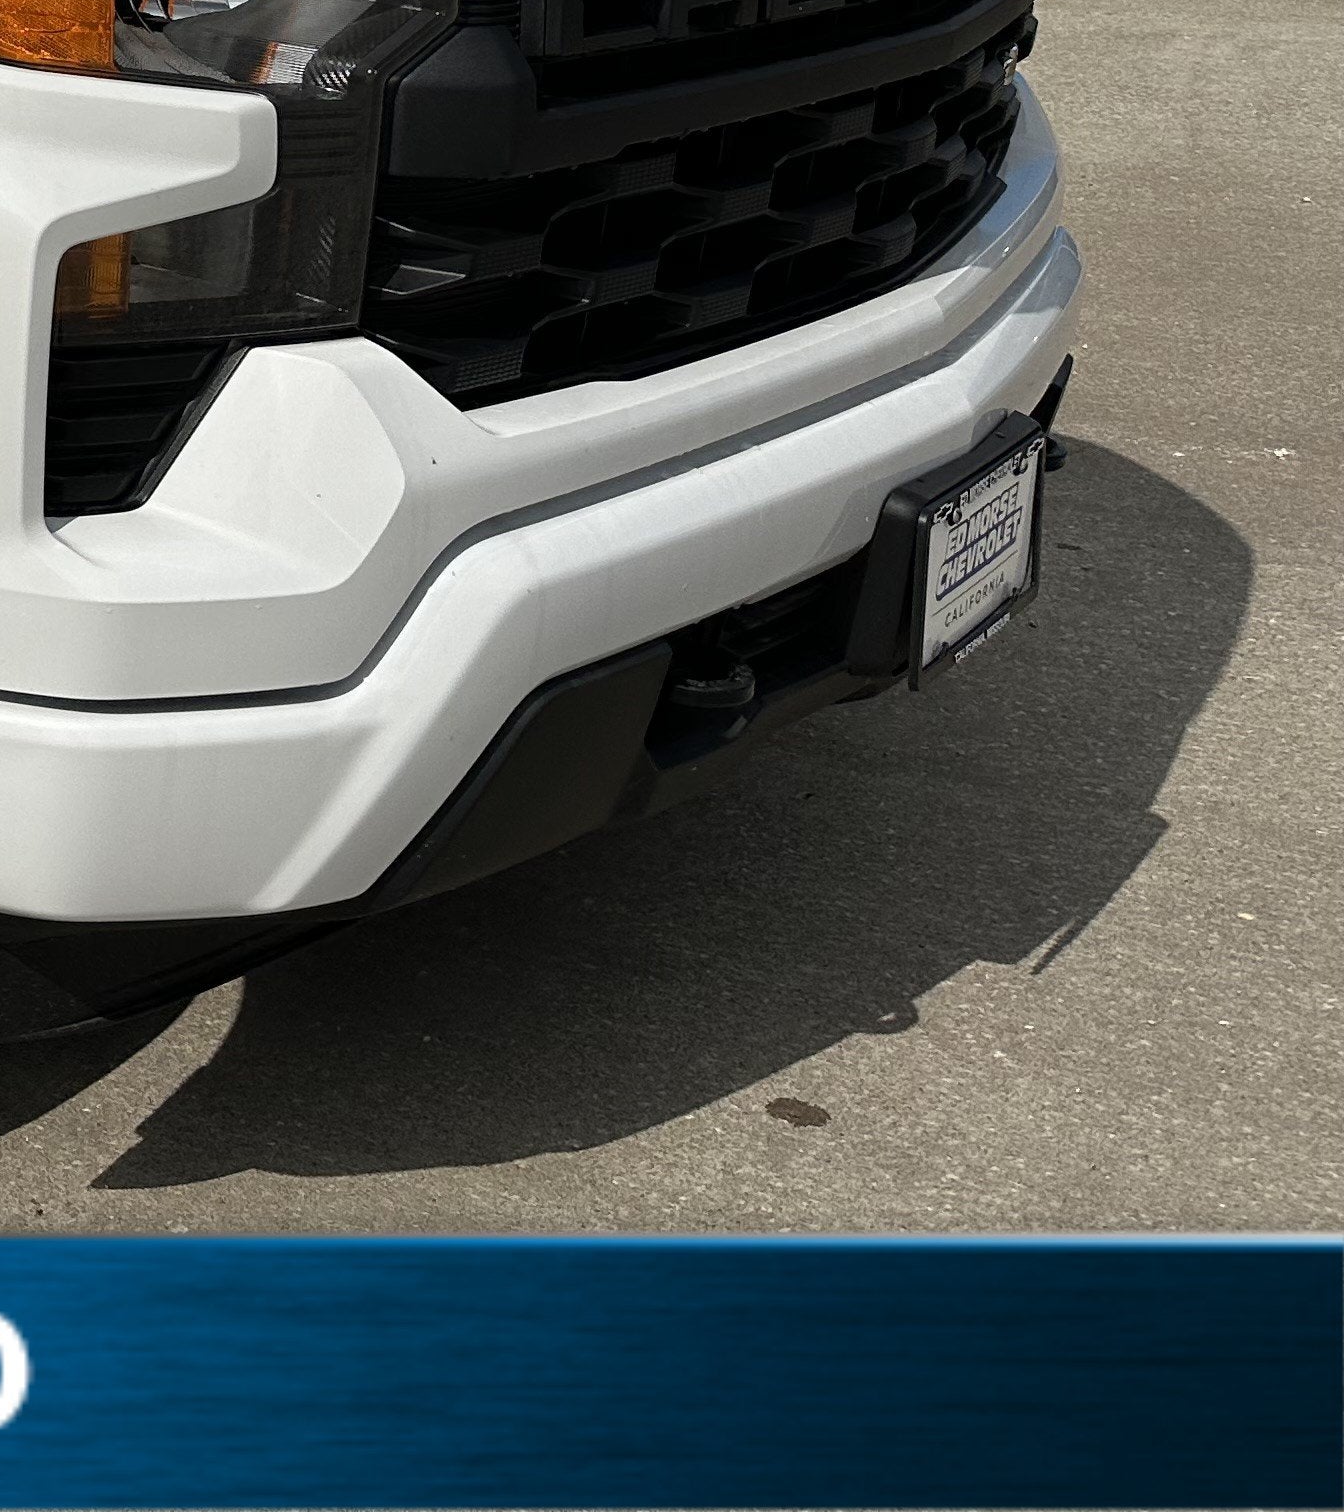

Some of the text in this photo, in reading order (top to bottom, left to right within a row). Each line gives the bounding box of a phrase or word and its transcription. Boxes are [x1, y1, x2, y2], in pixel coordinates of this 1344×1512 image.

[937, 507, 1022, 597] CHEVROLET
[944, 482, 1018, 560] ED MORSE
[945, 571, 1003, 627] CALIFORNIA
